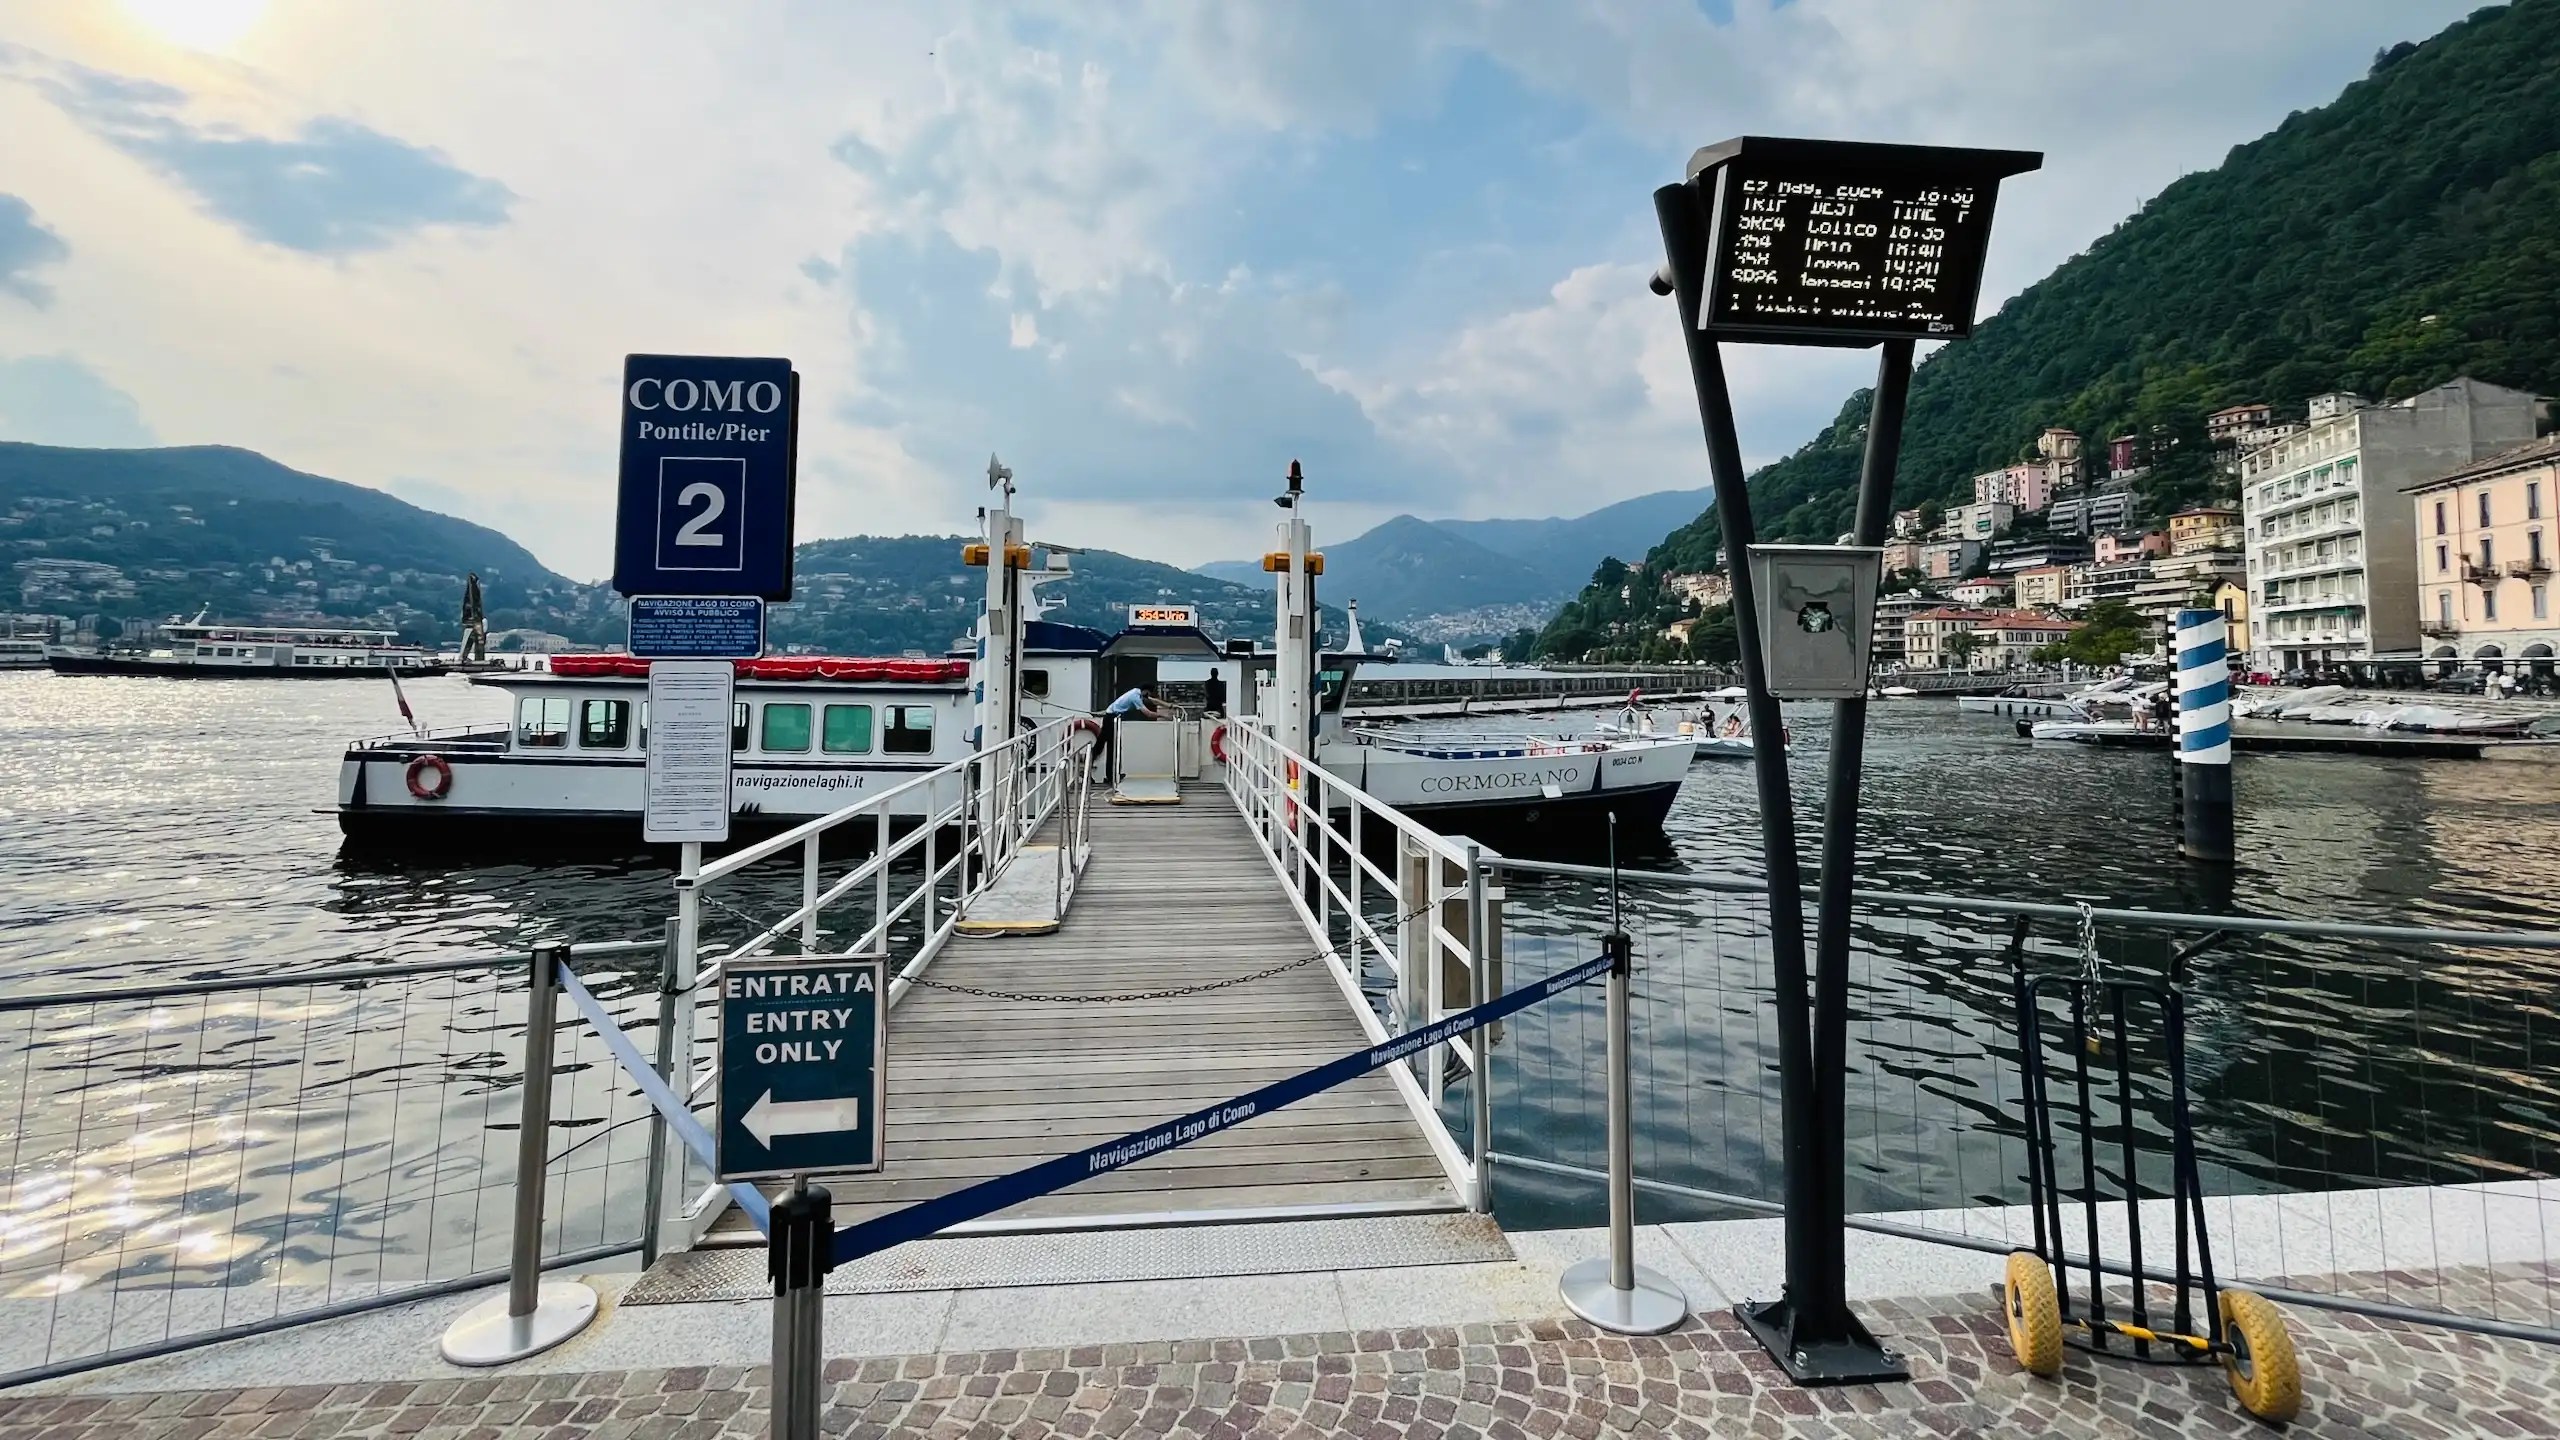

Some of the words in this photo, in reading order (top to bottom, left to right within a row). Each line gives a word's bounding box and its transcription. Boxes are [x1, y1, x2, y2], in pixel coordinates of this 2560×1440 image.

[629, 378, 782, 414] COMO
[638, 420, 771, 442] Pontile/Pier
[674, 482, 726, 547] 2
[637, 599, 694, 608] NAVIGAZIONE
[695, 599, 718, 608] LAGO
[720, 600, 729, 608] DI
[730, 600, 756, 608] COMO
[653, 609, 684, 617] AVVISO
[685, 609, 696, 617] AL
[697, 609, 740, 617] PUBBLICO
[1138, 608, 1186, 621] 354-Urio
[735, 774, 864, 791] navigazionelaghi.it
[1421, 767, 1579, 793] CORMORANO
[726, 972, 874, 999] ENTRATA
[746, 1007, 853, 1034] ENTRY
[755, 1038, 844, 1065] ONLY
[1370, 1036, 1422, 1067] Navigazione
[1423, 1028, 1443, 1047] Lago
[1444, 1023, 1452, 1037] di
[1453, 1016, 1475, 1033] Como
[1089, 1131, 1172, 1172] Navigazione
[1175, 1119, 1206, 1142] Lago
[1208, 1110, 1220, 1130] di
[1222, 1101, 1256, 1124] Como
